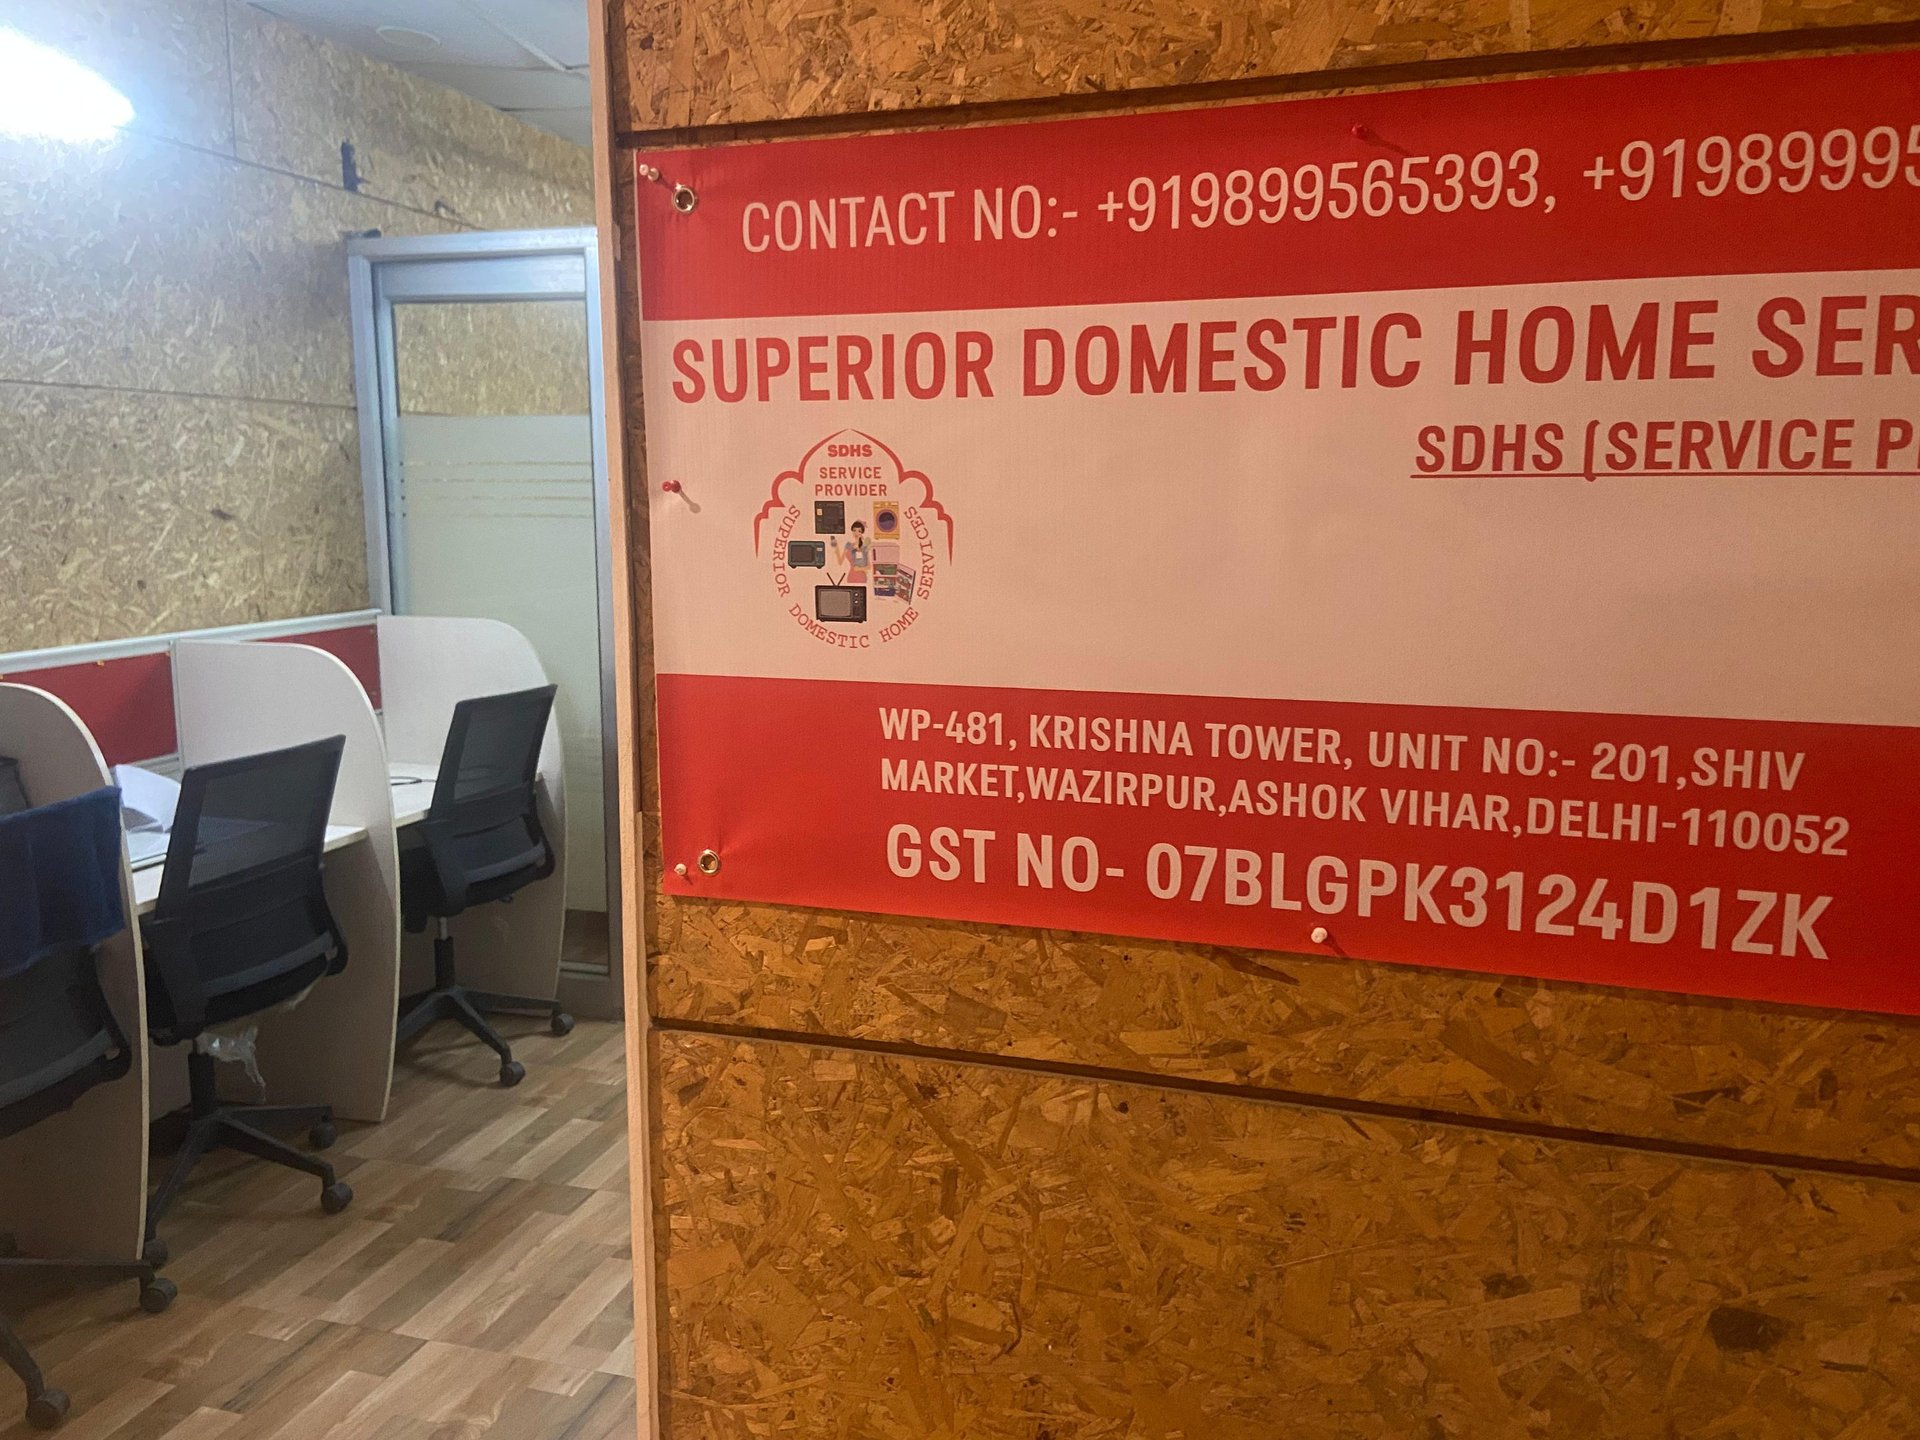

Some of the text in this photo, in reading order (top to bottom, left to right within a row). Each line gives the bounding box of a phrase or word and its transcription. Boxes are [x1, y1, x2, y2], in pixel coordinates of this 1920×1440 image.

[742, 190, 955, 253] CONTACT
[973, 184, 1078, 241] NO:-
[1097, 147, 1556, 233] +919899565393,
[672, 330, 995, 404] SUPERIOR
[1023, 312, 1423, 397] DOMESTIC
[1453, 299, 1719, 386] HOME
[819, 466, 882, 479] SERVICE
[827, 444, 873, 458] SDHS
[1415, 423, 1564, 473] SDHS
[814, 484, 888, 497] PROVIDER
[772, 504, 935, 649] SUPERIOR DOMESTIC HOME SERVICES
[878, 707, 1018, 751] WP-481,
[1029, 714, 1195, 756] KRISHNA
[1204, 722, 1353, 770] TOWER,
[1367, 730, 1468, 772] UNIT
[1482, 736, 1577, 778] NO:-
[886, 823, 1834, 961] GST NO- 07BLGPK3124D1ZK
